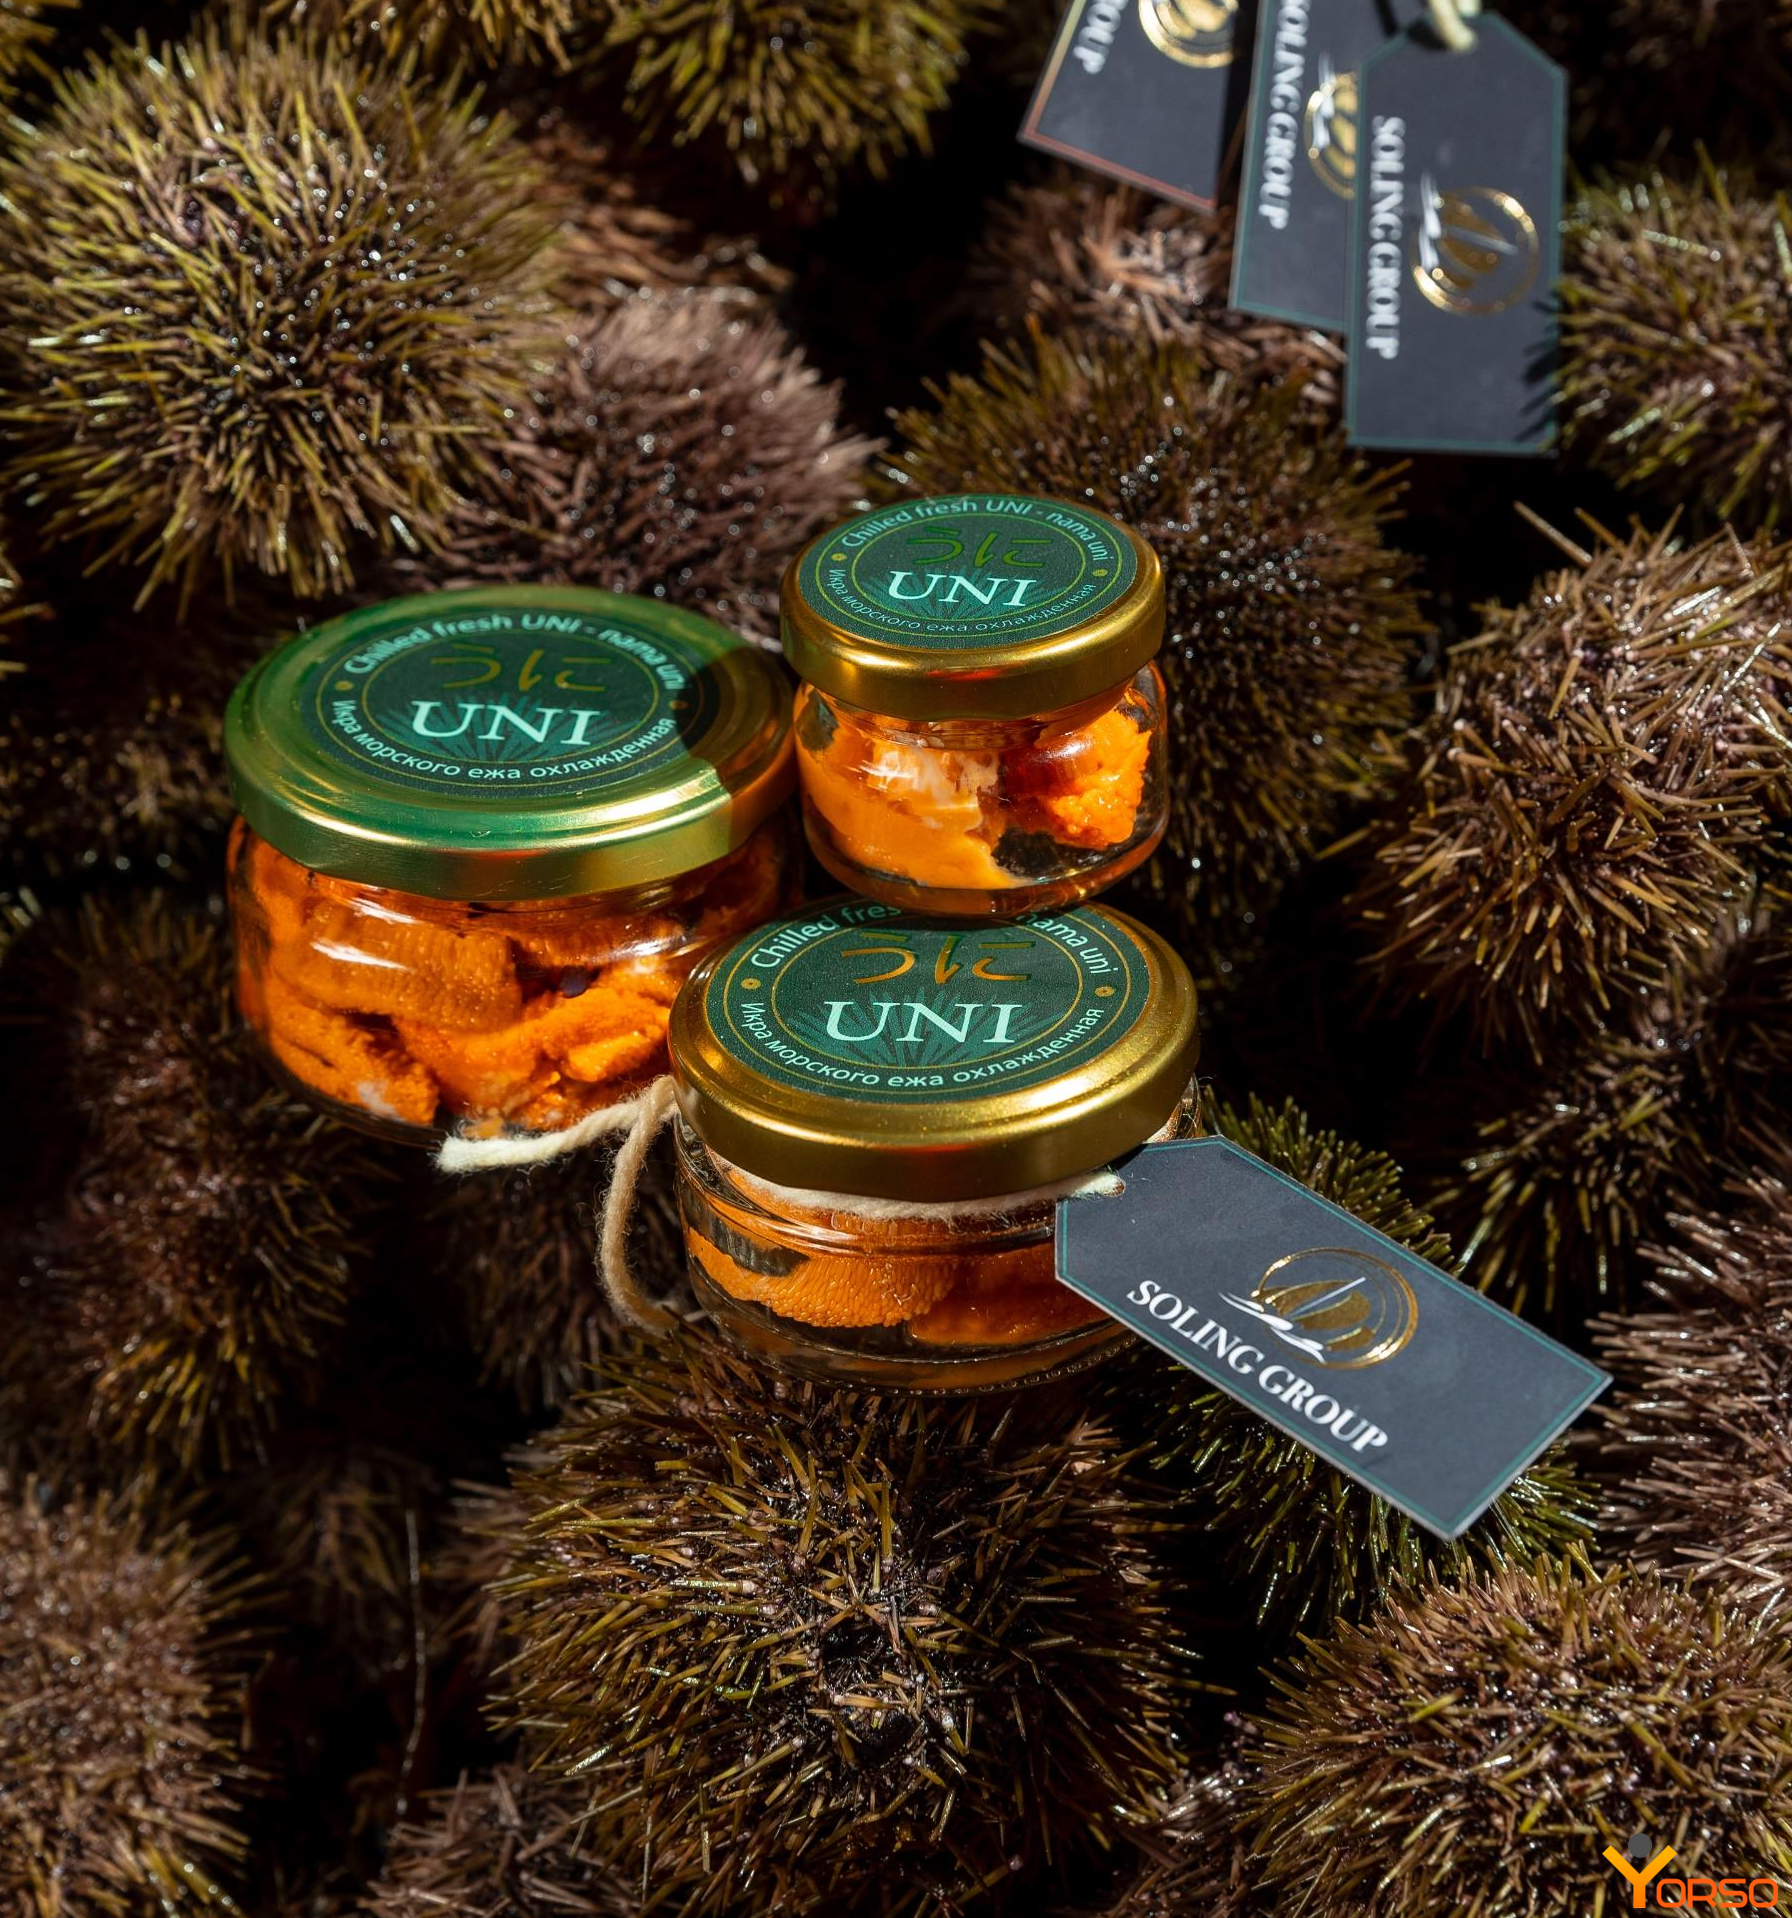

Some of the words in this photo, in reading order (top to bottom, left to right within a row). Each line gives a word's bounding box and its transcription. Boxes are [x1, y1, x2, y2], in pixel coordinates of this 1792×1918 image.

[1258, 112, 1299, 229] GROUP
[1371, 116, 1406, 241] SOLING
[1365, 242, 1402, 360] GROUP
[842, 511, 912, 547] Chilled
[914, 500, 978, 518] fresh
[986, 500, 1033, 516] UNI
[1045, 511, 1094, 541] nama
[1087, 540, 1114, 562] uni
[906, 526, 1054, 569] うに
[828, 569, 848, 601] Икра
[843, 595, 921, 630] морского
[926, 623, 967, 632] ежа
[976, 583, 1097, 632] охлажденная
[889, 570, 1038, 607] UNI
[344, 627, 433, 674] Chilled
[432, 613, 512, 638] fresh
[522, 613, 581, 634] UNI
[597, 628, 667, 666] nama
[656, 664, 692, 690] uni
[431, 643, 611, 692] うに
[332, 700, 362, 734] Икра
[353, 733, 461, 777] морского
[468, 767, 521, 780] ежа
[533, 717, 677, 780] охлажденная
[410, 700, 601, 746] UNI
[751, 913, 840, 969] Chilled
[842, 931, 1036, 984] うに
[1080, 947, 1118, 974] uni
[740, 1001, 771, 1044] Икра
[767, 1039, 880, 1086] морского
[888, 1075, 944, 1088] ежа
[953, 1007, 1105, 1082] охлажденная
[823, 1001, 1022, 1044] UNI
[1127, 1279, 1266, 1376] SOLING
[1259, 1365, 1389, 1453] GROUP
